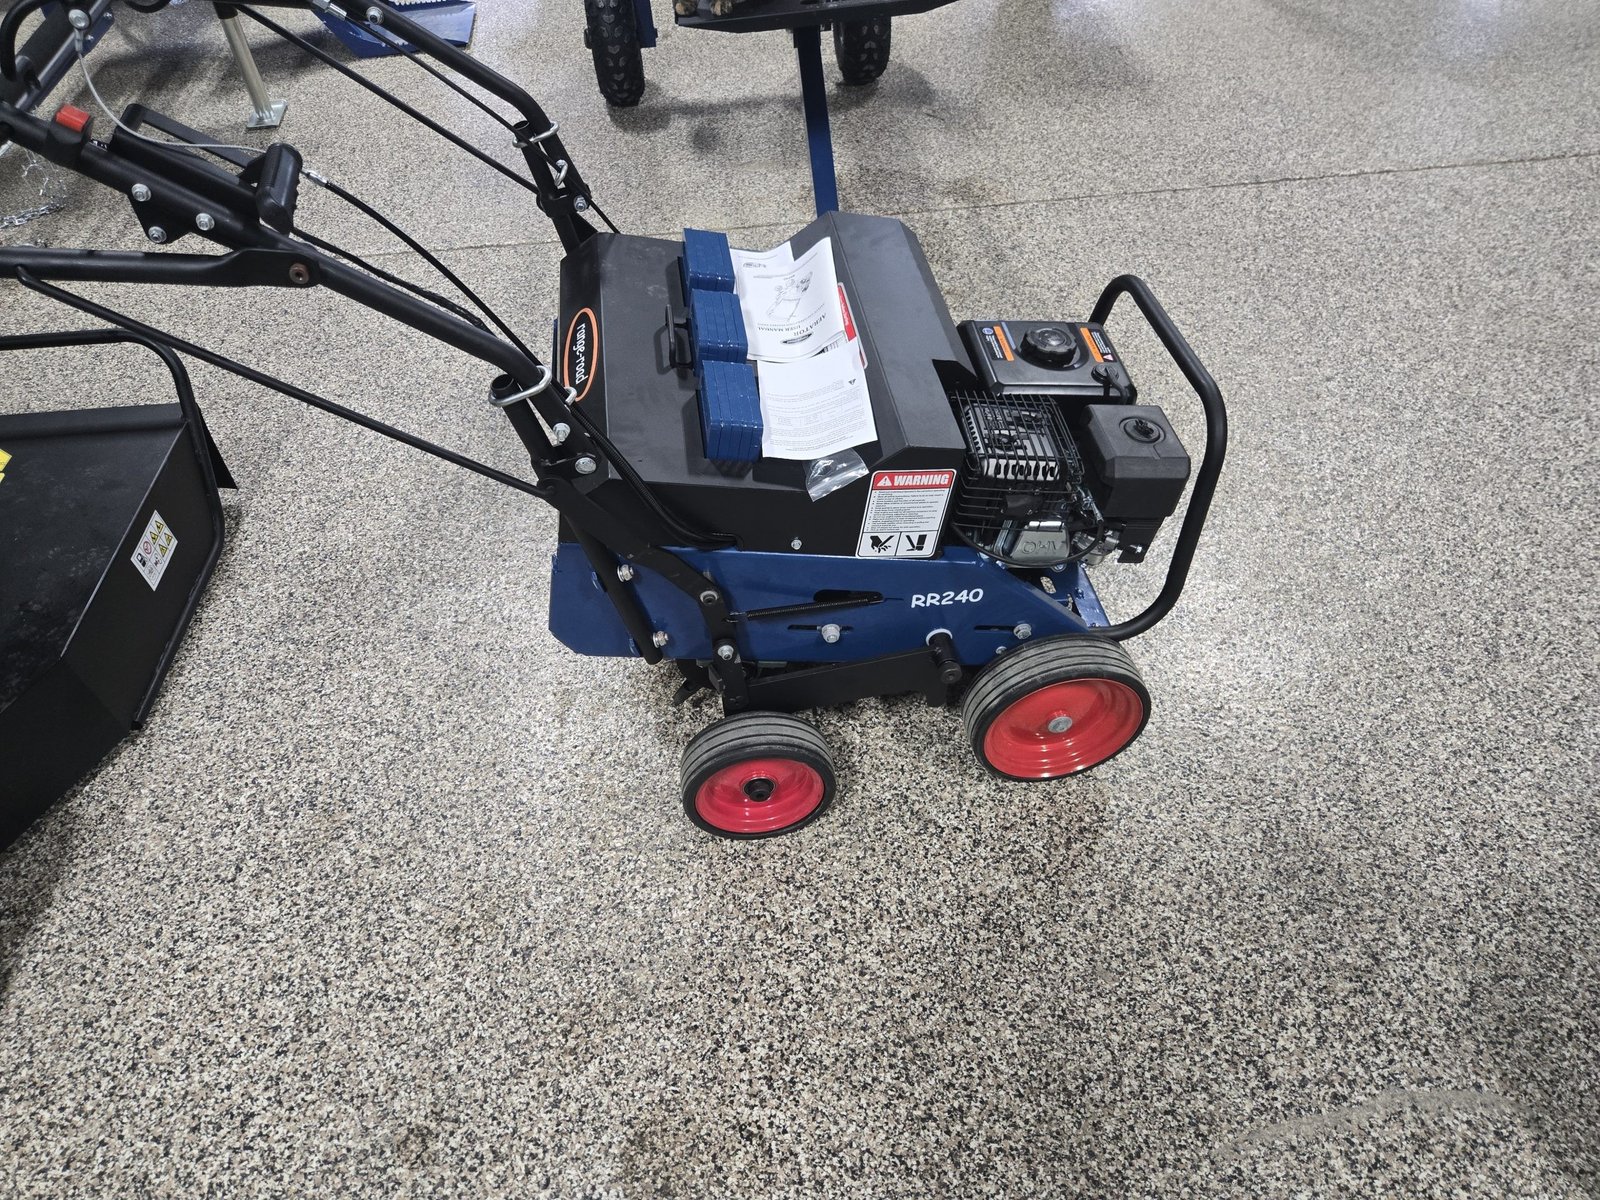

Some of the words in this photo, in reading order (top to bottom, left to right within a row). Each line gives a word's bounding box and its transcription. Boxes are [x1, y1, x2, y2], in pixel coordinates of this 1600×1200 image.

[573, 323, 589, 384] range-road
[893, 474, 950, 487] WARNING
[911, 588, 984, 608] RR240
